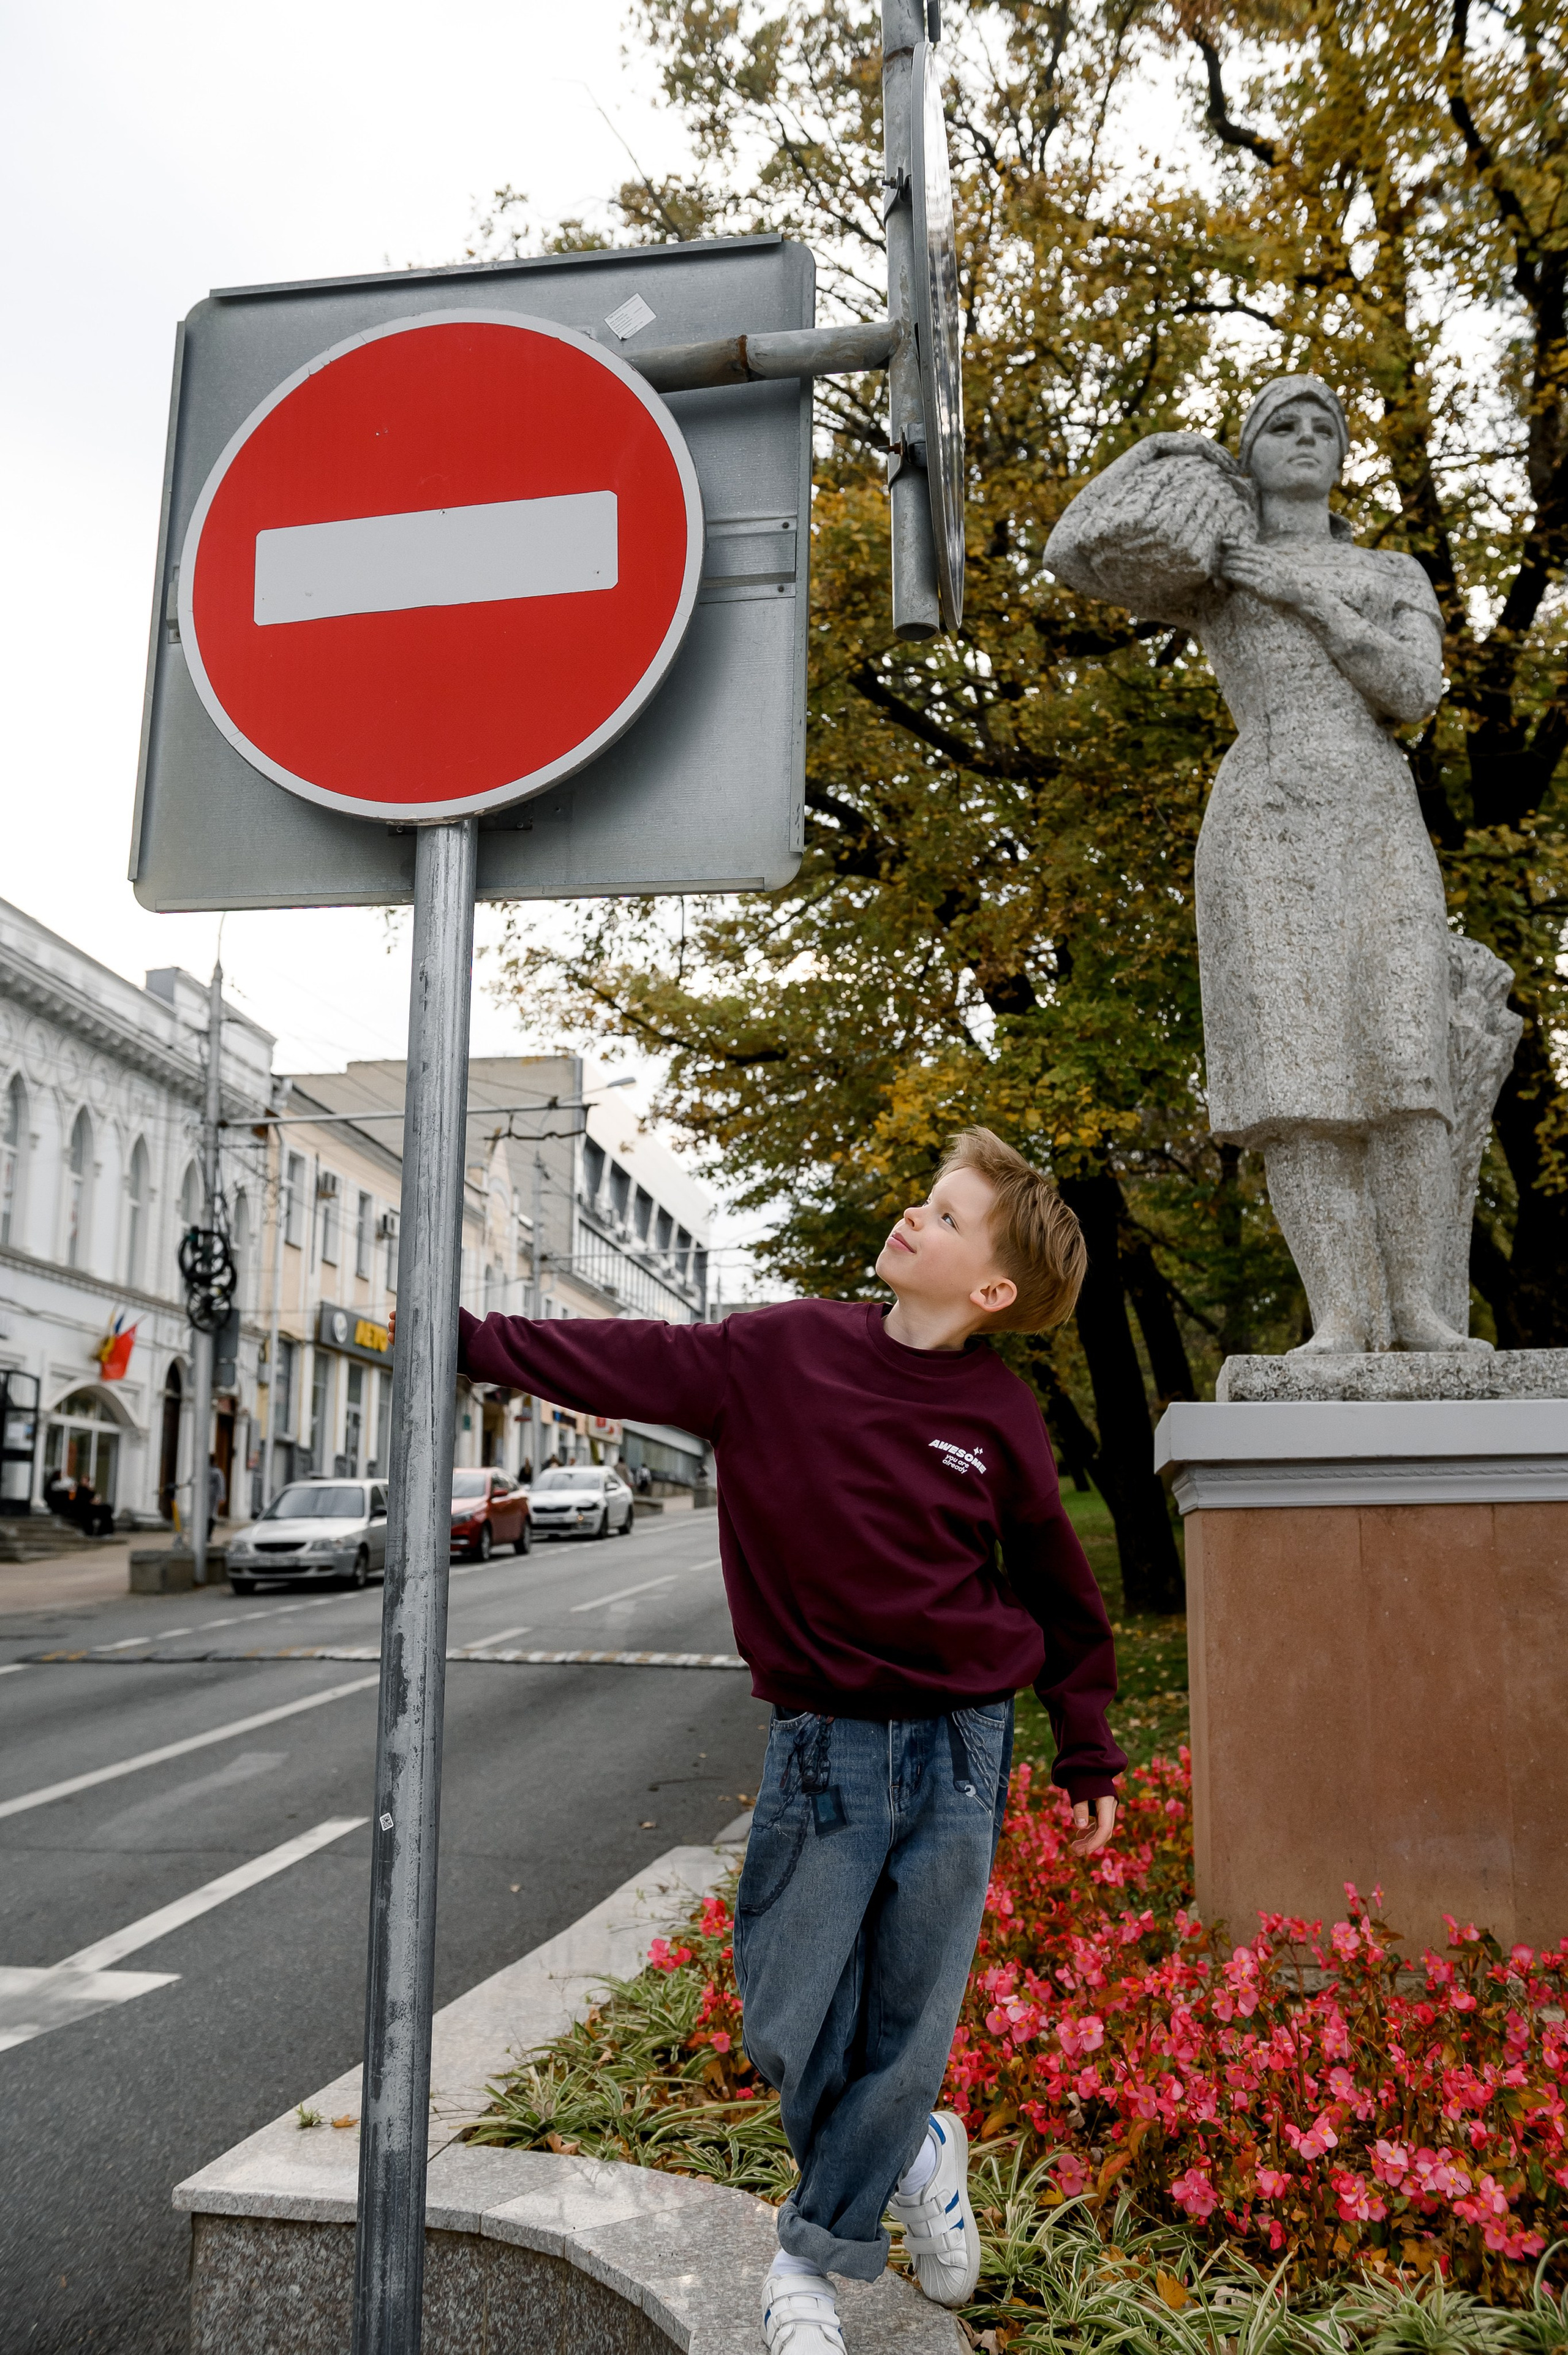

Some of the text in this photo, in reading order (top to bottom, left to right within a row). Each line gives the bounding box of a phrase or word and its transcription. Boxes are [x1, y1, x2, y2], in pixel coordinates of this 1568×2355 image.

[928, 1439, 987, 1474] AWESOME
[944, 1454, 970, 1469] you are
[942, 1459, 968, 1474] already
